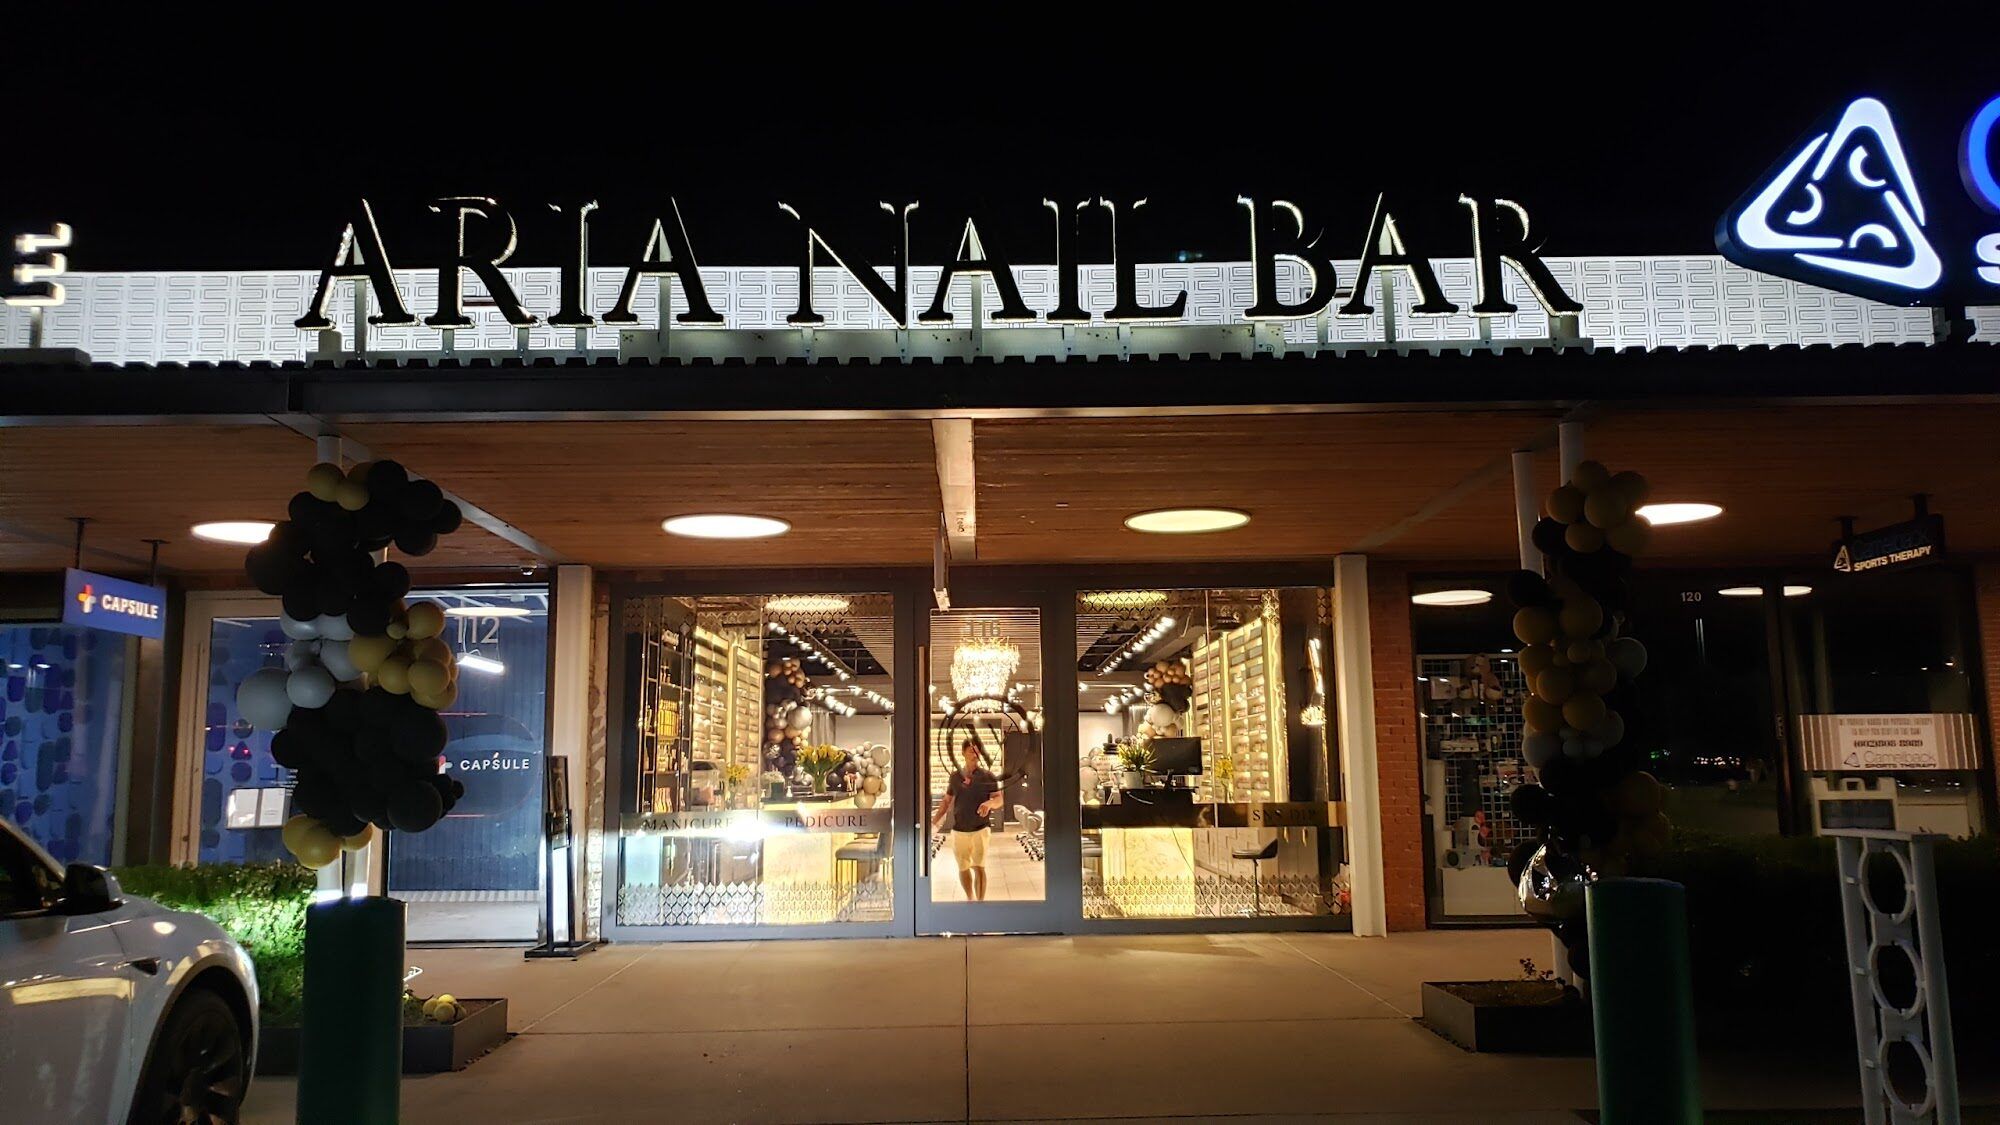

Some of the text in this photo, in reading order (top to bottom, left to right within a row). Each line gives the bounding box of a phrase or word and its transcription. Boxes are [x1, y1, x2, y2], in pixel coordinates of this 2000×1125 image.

[294, 191, 1584, 329] ARIA NAIL BAR
[1853, 545, 1932, 572] SPORTS THERAPY
[102, 594, 159, 619] CAPSULE
[1680, 591, 1702, 602] 120
[454, 616, 499, 644] 112
[966, 619, 1001, 638] 116
[460, 757, 530, 771] CAPSULE
[785, 814, 868, 828] PEDICURE
